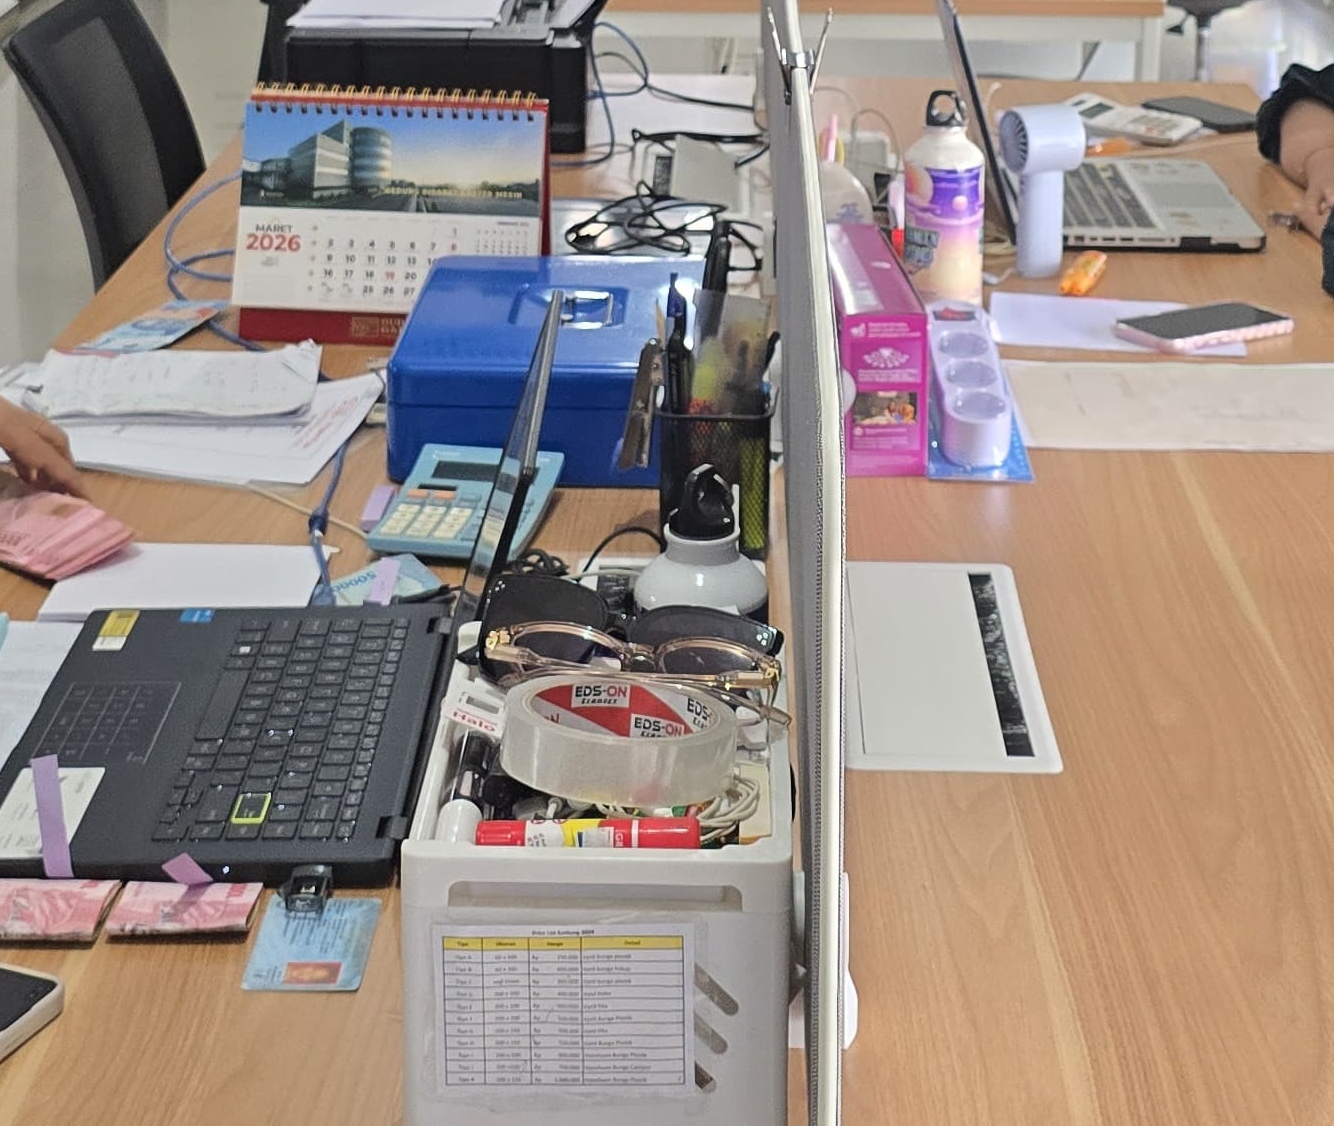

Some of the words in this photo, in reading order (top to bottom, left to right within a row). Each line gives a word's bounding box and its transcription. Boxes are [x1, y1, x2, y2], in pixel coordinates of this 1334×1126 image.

[255, 224, 293, 233] MARET
[246, 234, 301, 252] 2026
[574, 685, 628, 698] EDS-ON
[633, 717, 684, 738] EDS-ON
